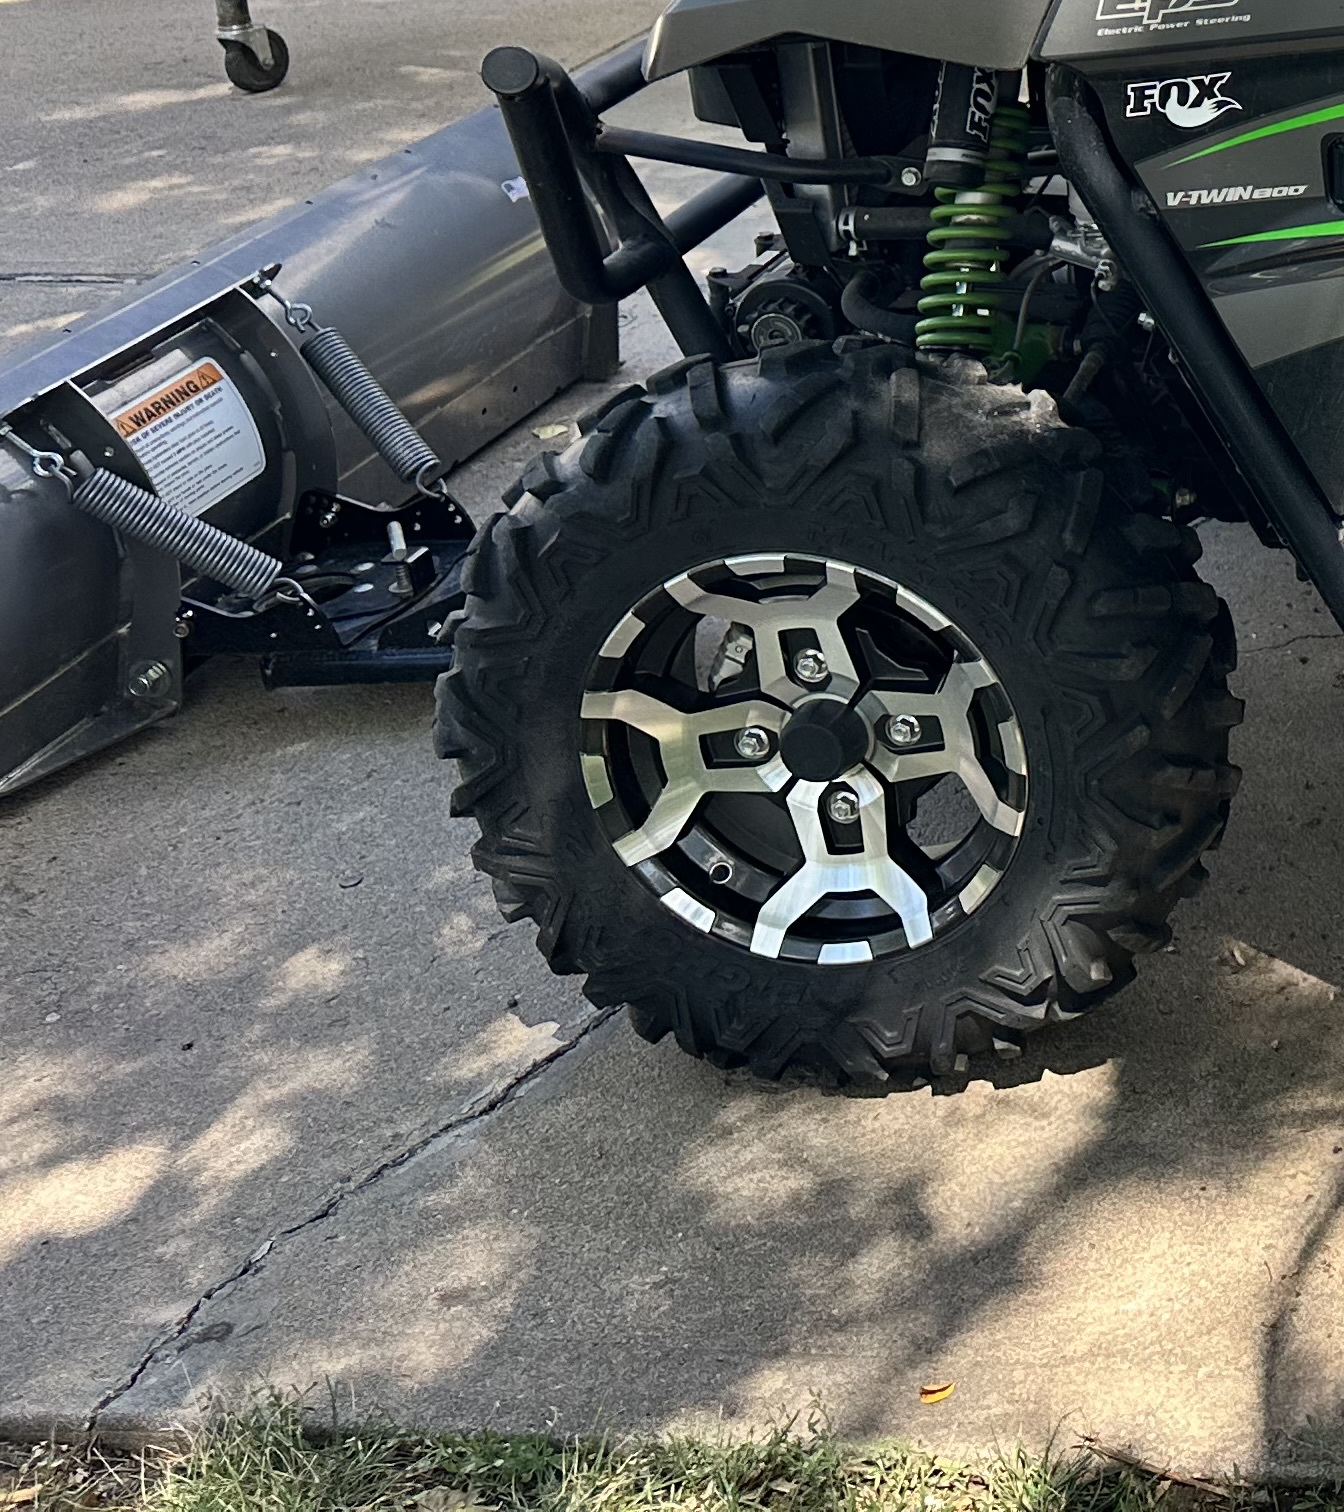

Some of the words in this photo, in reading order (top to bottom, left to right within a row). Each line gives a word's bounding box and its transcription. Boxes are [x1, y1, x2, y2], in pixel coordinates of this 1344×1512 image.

[1096, 25, 1145, 37] Electric
[1149, 20, 1191, 32] Power
[1195, 14, 1251, 27] Steering
[965, 66, 999, 143] FOX
[1126, 71, 1242, 126] FOX
[128, 378, 201, 428] WARNING
